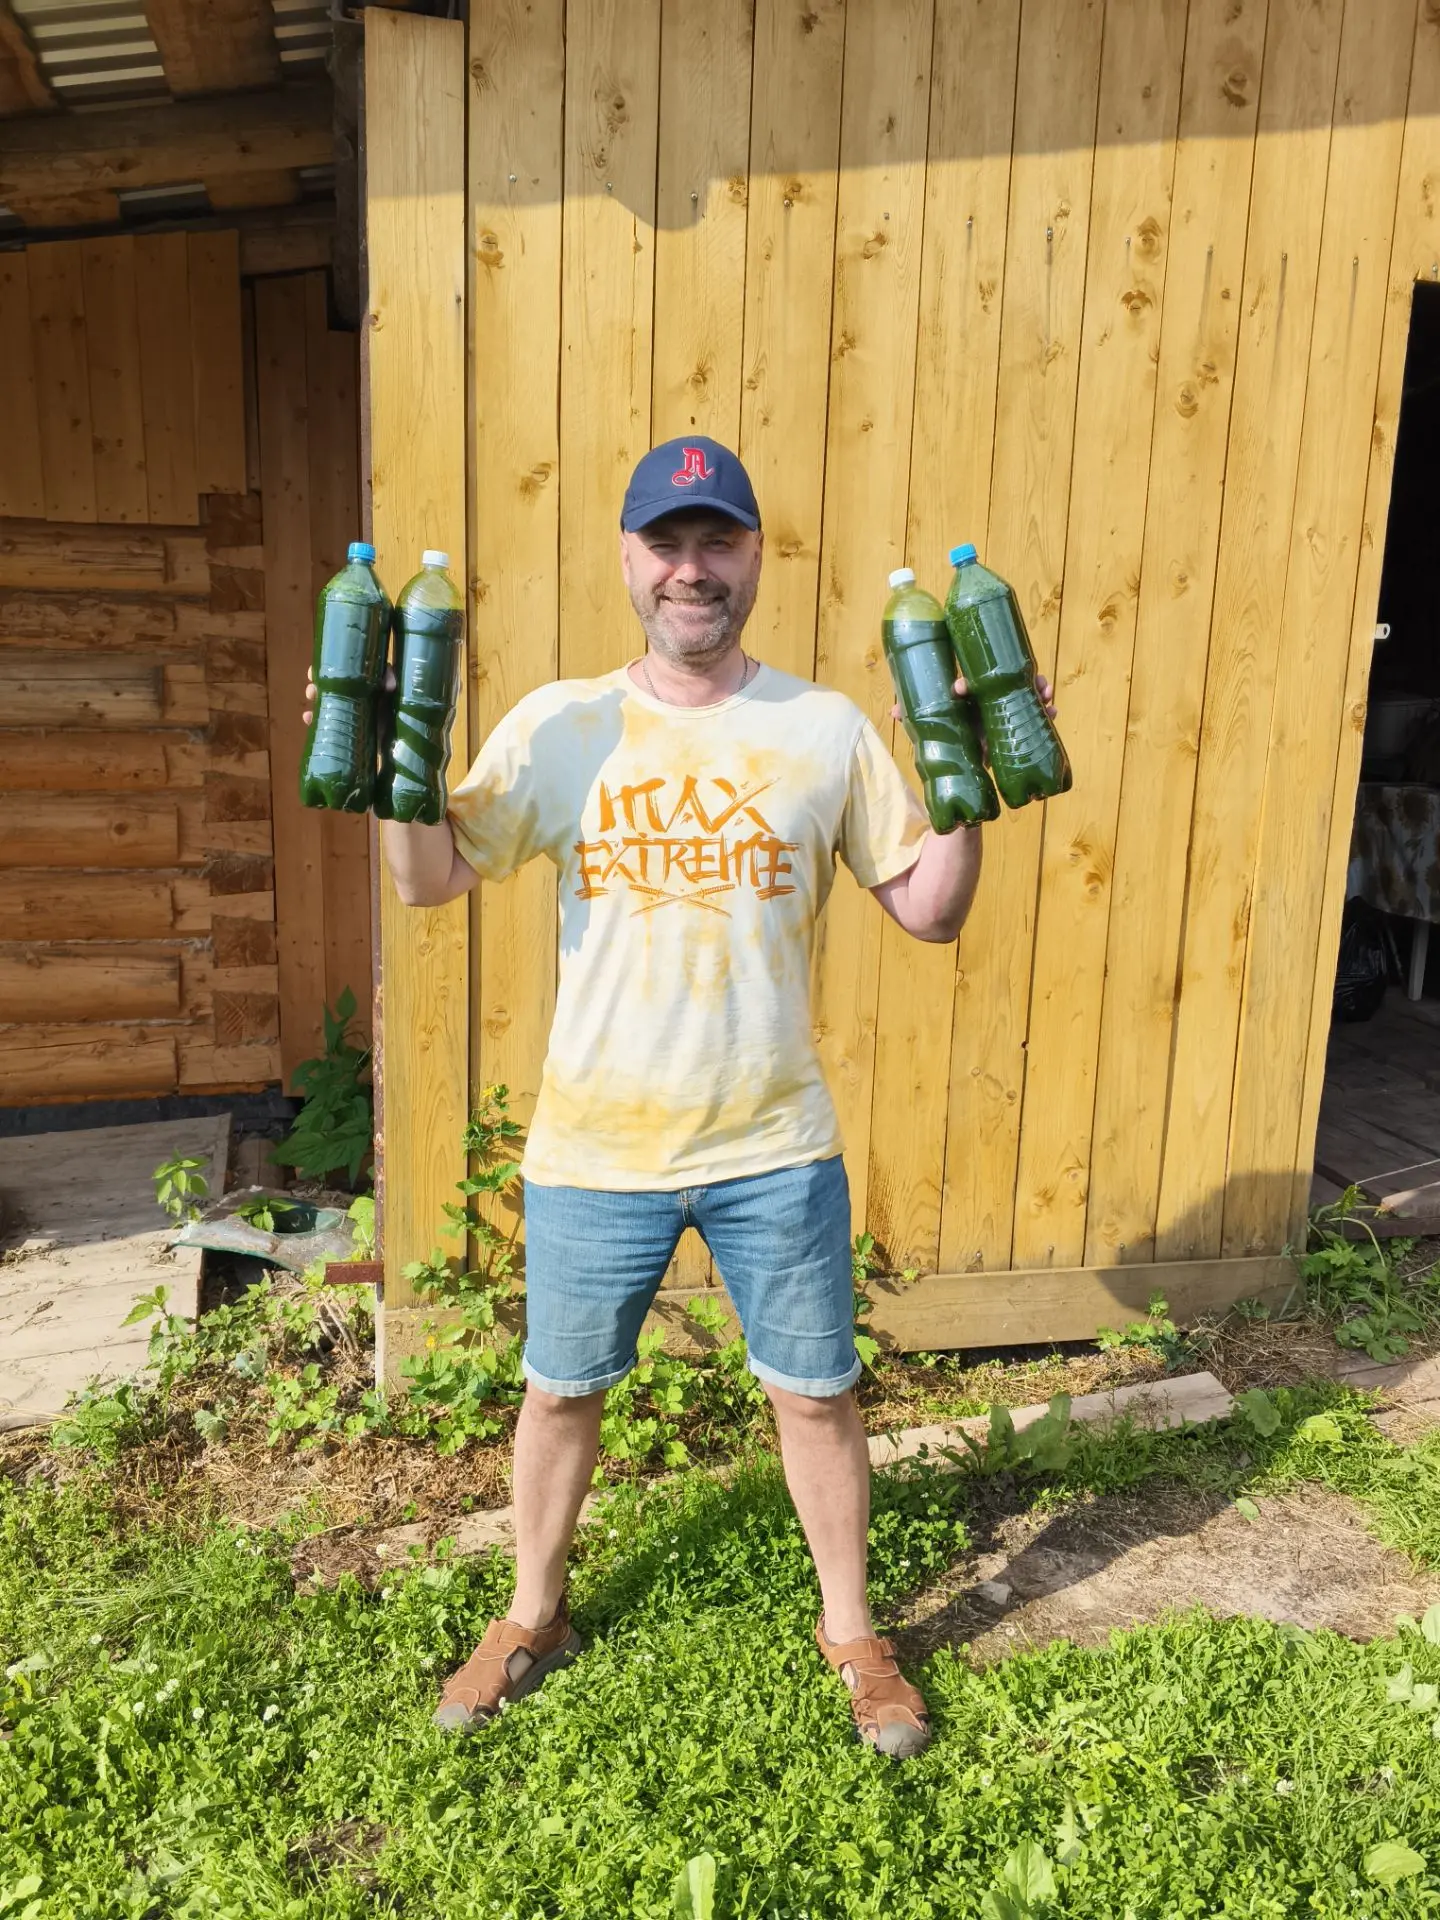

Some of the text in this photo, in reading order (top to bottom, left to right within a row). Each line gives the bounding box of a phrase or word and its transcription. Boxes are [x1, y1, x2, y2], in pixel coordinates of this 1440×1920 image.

[672, 447, 714, 486] A
[599, 774, 781, 834] MAX
[573, 832, 801, 900] EXTREME
